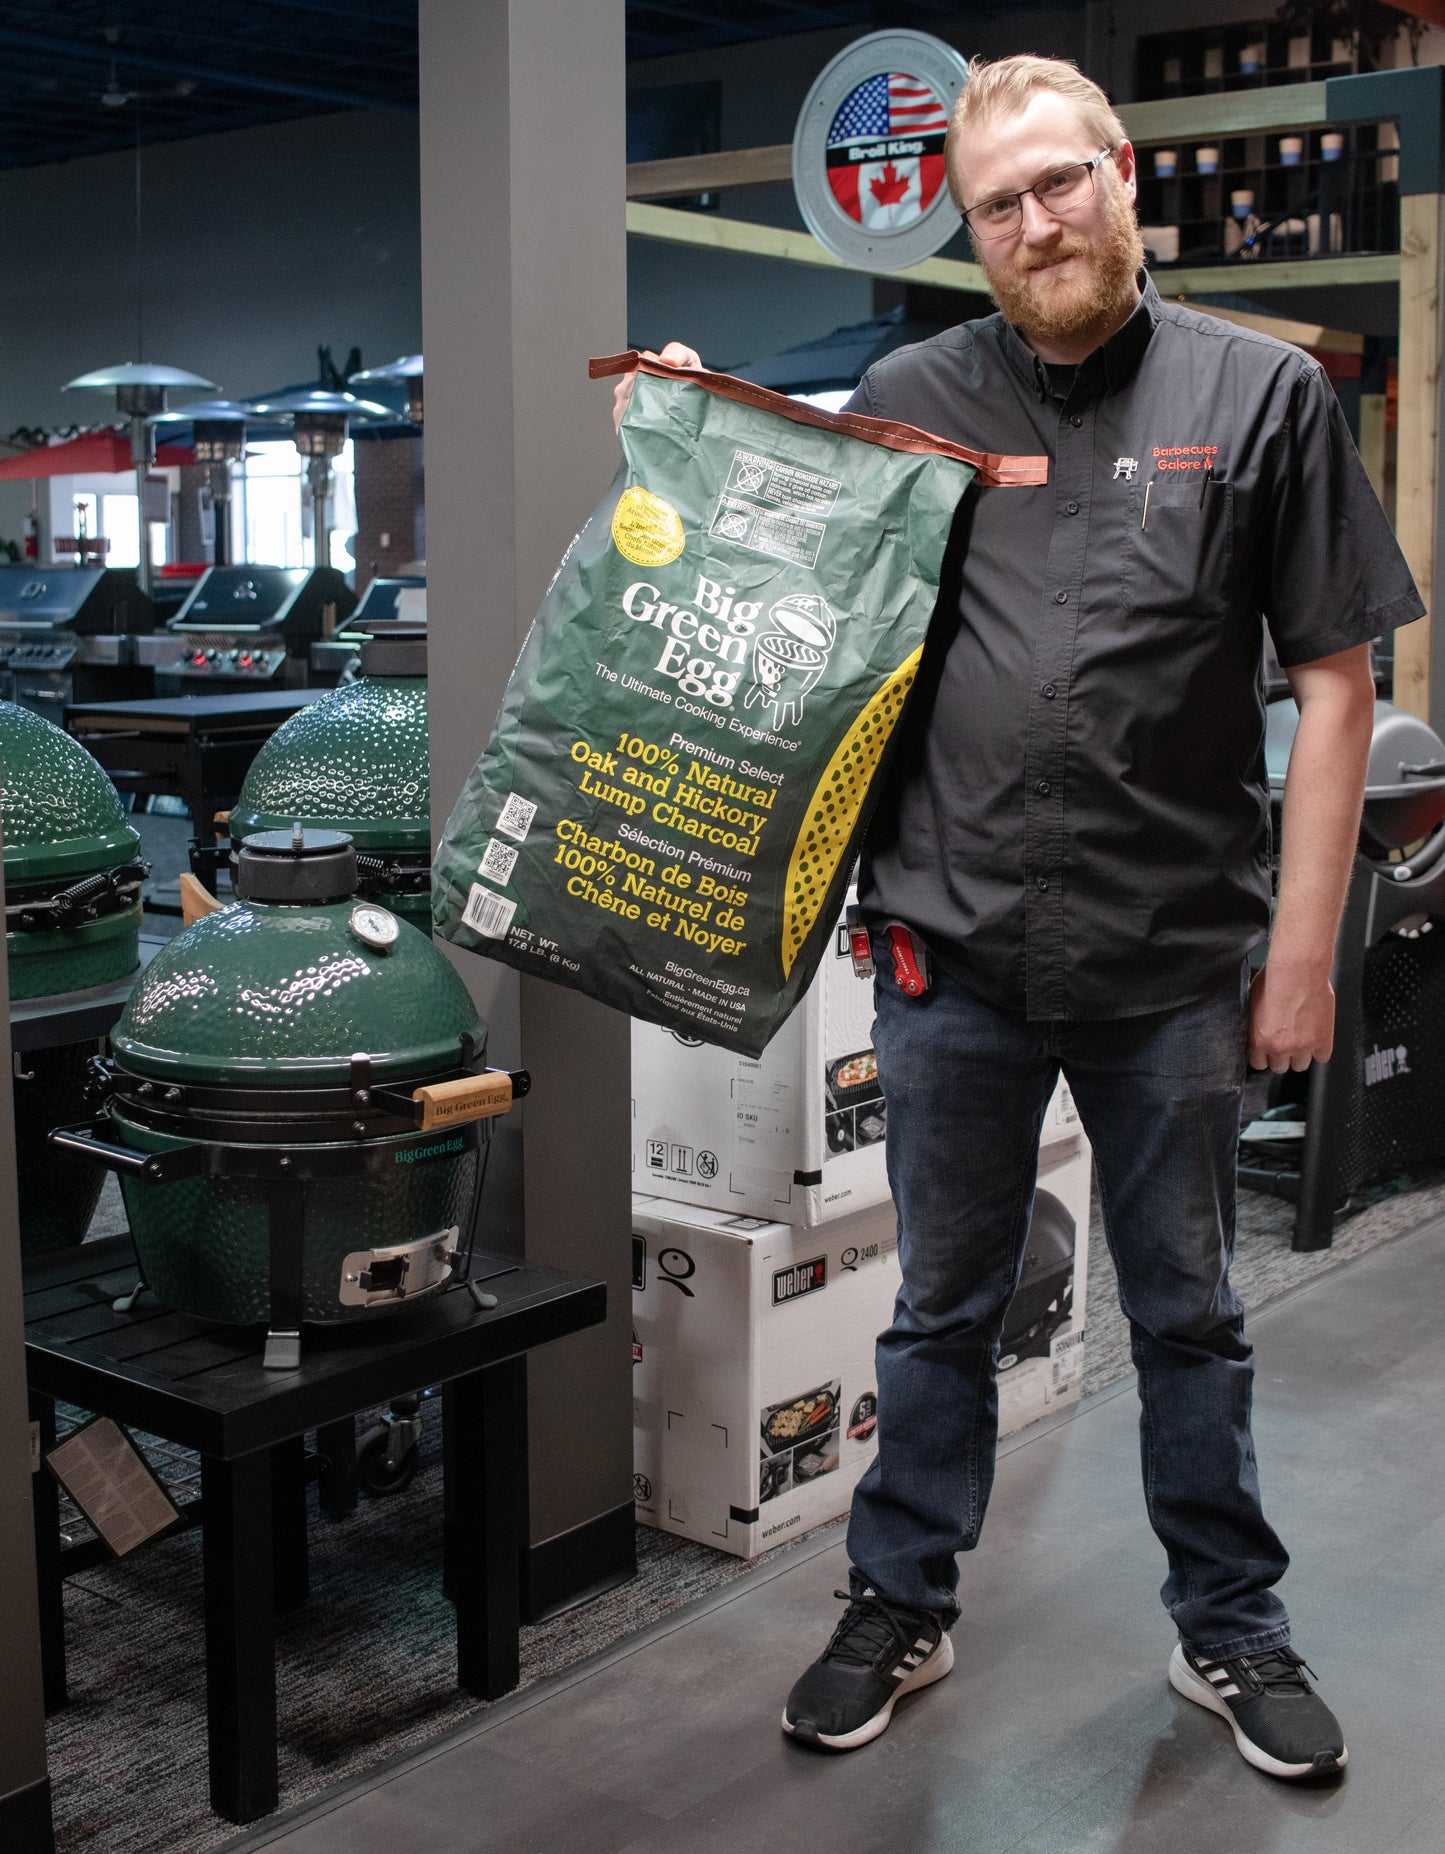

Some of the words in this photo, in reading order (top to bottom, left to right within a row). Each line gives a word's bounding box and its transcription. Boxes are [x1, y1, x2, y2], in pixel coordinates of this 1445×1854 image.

[848, 143, 886, 160] Broil
[888, 141, 923, 155] King
[742, 452, 775, 470] WARNING
[1152, 446, 1218, 457] Barbecues
[1157, 458, 1201, 470] Galore
[694, 575, 764, 636] Big
[623, 582, 749, 665] Green
[654, 635, 741, 707] Egg
[595, 662, 618, 682] The
[621, 674, 672, 704] Ultimate
[675, 696, 726, 729] Cooking
[728, 717, 798, 751] Experience
[616, 733, 680, 775] 100%
[685, 760, 778, 810] Natural
[669, 732, 735, 769] Premium
[739, 760, 784, 786] Select
[571, 741, 618, 777] Oak
[622, 766, 671, 798] and
[673, 783, 768, 835] Hickory
[579, 771, 646, 816] Lump
[652, 802, 761, 856] Charcoal
[556, 819, 656, 876] Charbon
[661, 864, 692, 889] de
[696, 875, 749, 907] Bois
[618, 823, 686, 860] Sélection
[688, 851, 752, 882] Prémium
[554, 844, 616, 886] 100%
[622, 872, 713, 922] Naturel
[715, 908, 745, 931] de
[567, 876, 641, 920] Chêne
[646, 912, 671, 932] et
[673, 918, 747, 956] Noyer
[508, 938, 528, 951] 17.6
[529, 945, 547, 958] LB.
[550, 953, 560, 963] (8
[562, 958, 581, 972] Kg)
[510, 926, 535, 941] NET
[539, 937, 559, 952] WT.
[629, 964, 645, 975] ALL
[646, 971, 686, 991] NATURAL
[692, 988, 718, 1003] MADE
[719, 998, 729, 1007] IN
[730, 1001, 746, 1012] USA
[665, 961, 750, 996] BigGreenEgg.ca
[664, 991, 713, 1014] Entièrement
[714, 1010, 743, 1024] naturel
[680, 1007, 696, 1017] aux
[696, 1011, 739, 1032] États-Unis
[436, 1105, 454, 1116] Big
[455, 1098, 486, 1112] Green
[487, 1093, 506, 1104] Egg
[745, 1113, 758, 1122] SKU
[650, 1142, 664, 1156] 12
[824, 1189, 852, 1204] weber.com
[861, 1243, 878, 1260] 2400
[776, 1265, 814, 1299] weber
[761, 1515, 801, 1539] weber.com
